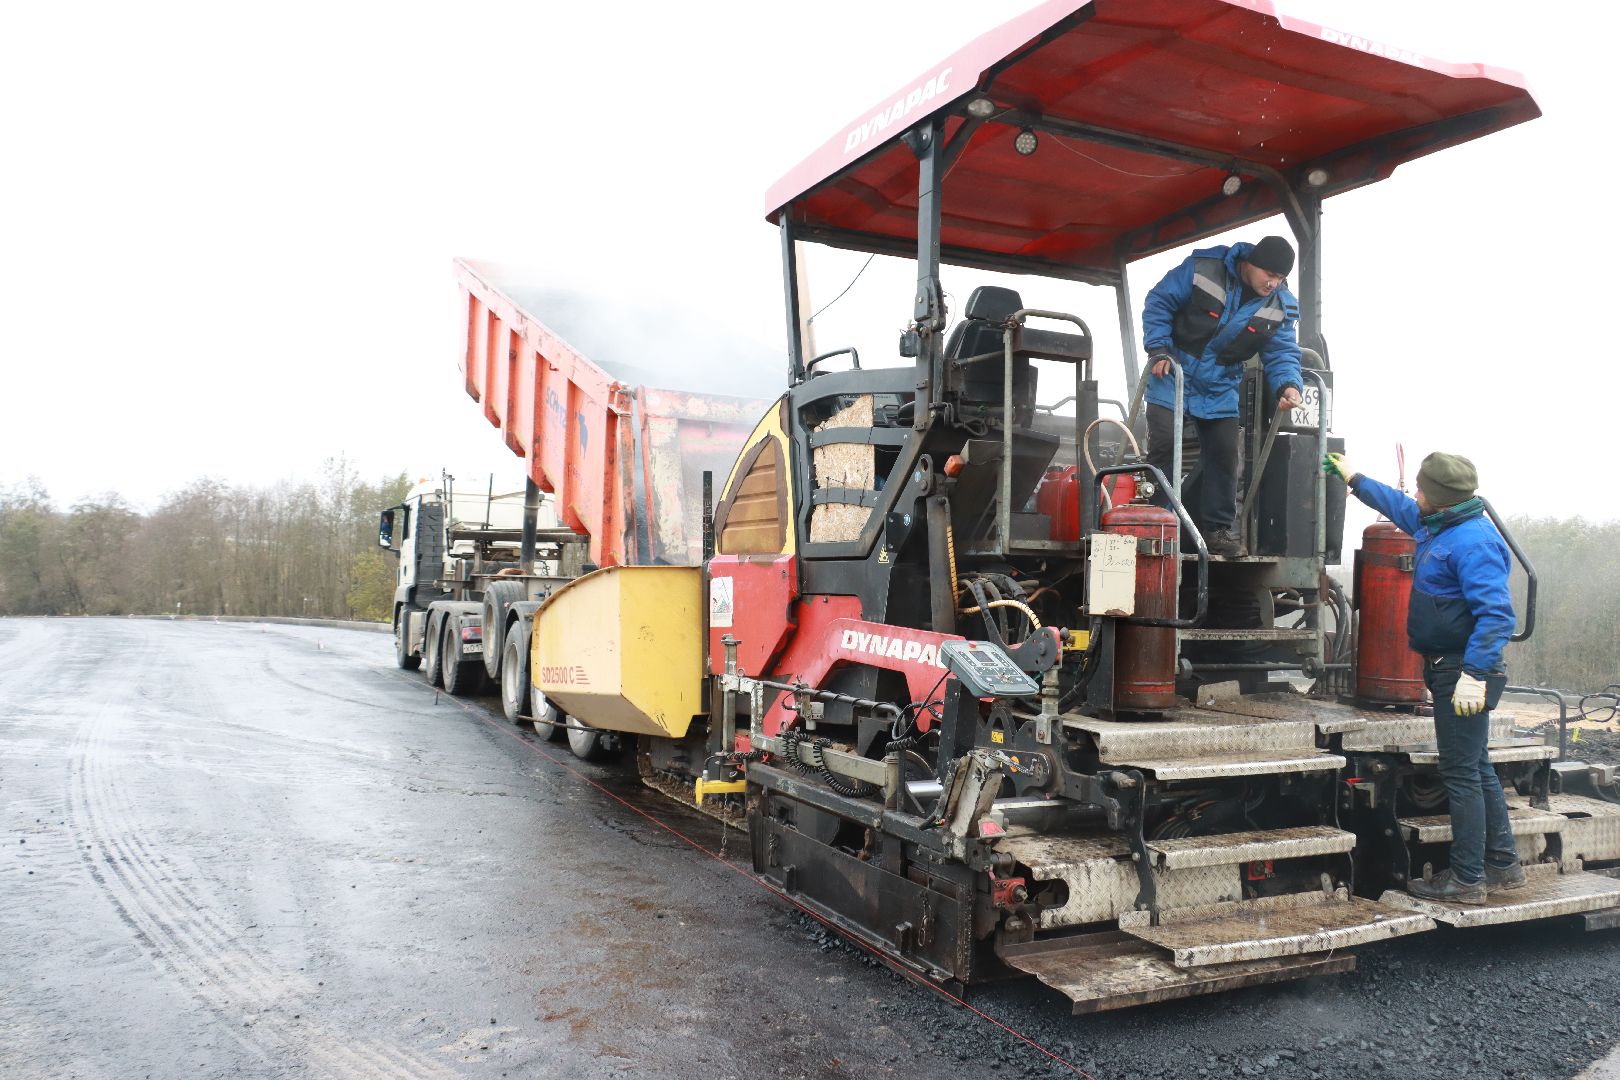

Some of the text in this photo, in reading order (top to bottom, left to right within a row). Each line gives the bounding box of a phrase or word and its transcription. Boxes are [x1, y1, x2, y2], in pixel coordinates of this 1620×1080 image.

[844, 67, 952, 154] DYNAPAC
[542, 666, 575, 685] SD2500 C
